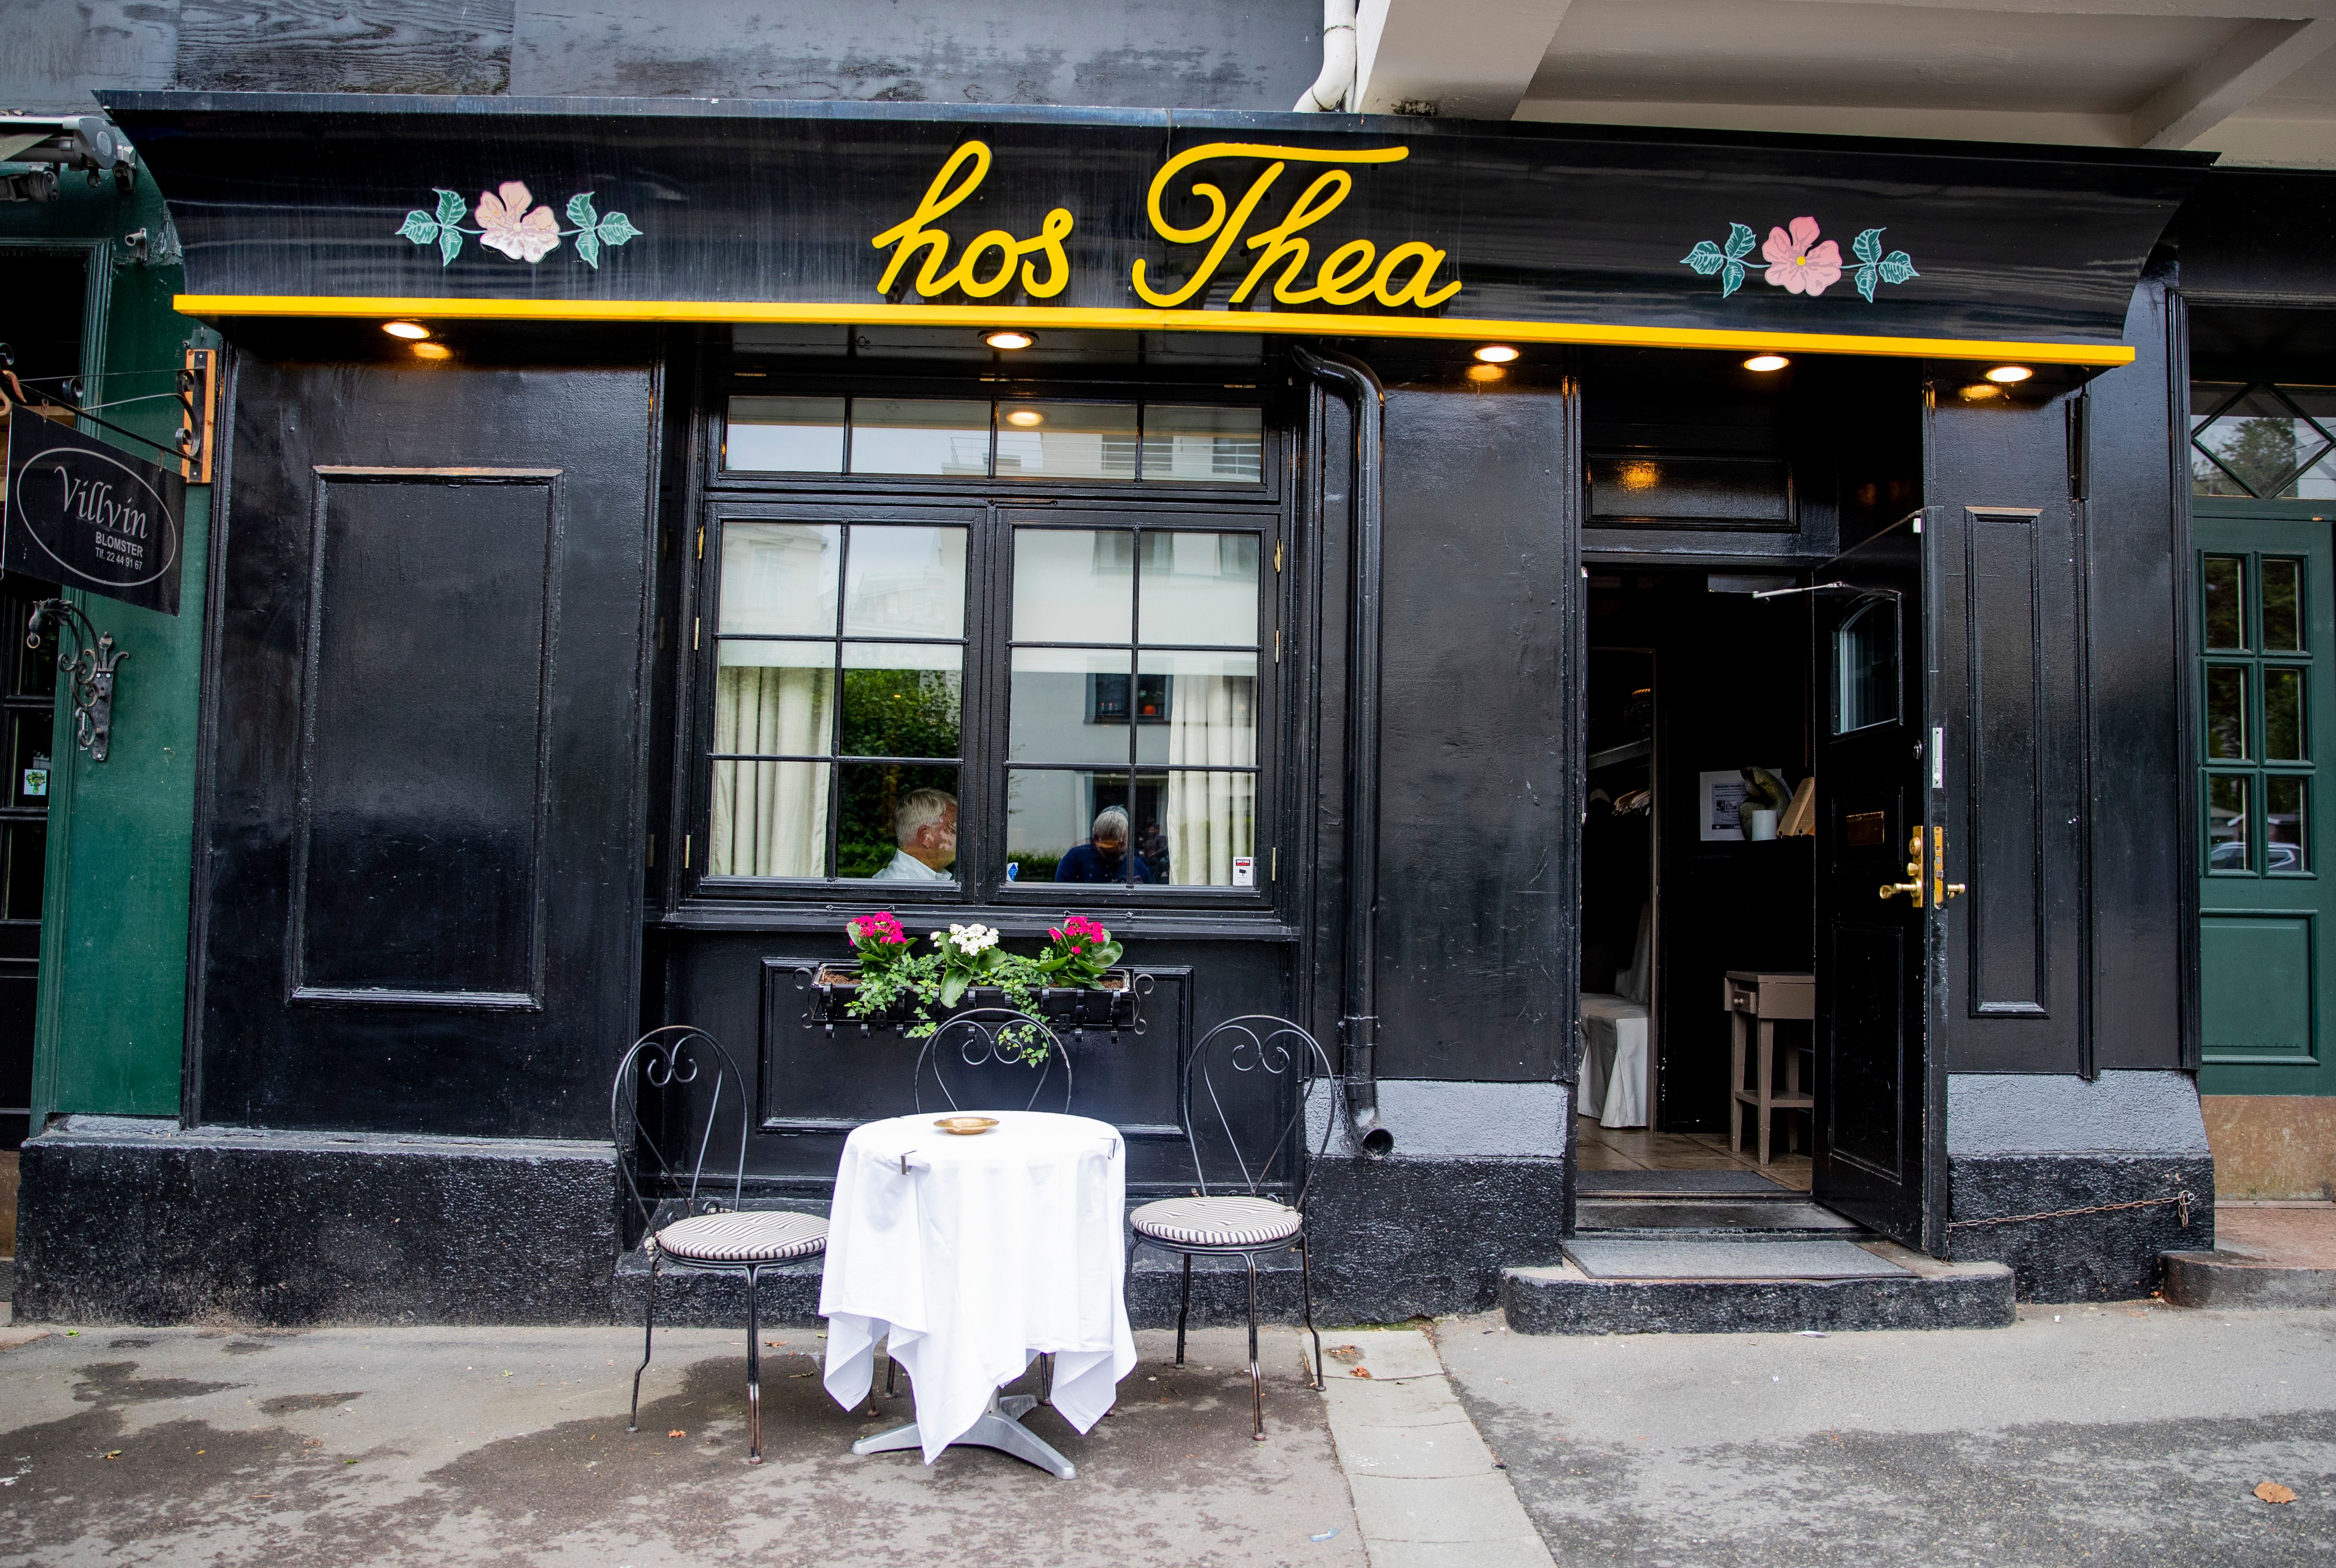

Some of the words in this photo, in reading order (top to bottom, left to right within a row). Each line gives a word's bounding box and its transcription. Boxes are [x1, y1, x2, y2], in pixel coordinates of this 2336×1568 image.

[871, 140, 1074, 298] hos
[1131, 142, 1463, 308] Thea
[54, 466, 147, 539] Villvin
[95, 547, 105, 559] Tlf.
[107, 551, 115, 562] 22
[116, 555, 124, 565] 44
[126, 557, 133, 568] 91
[135, 560, 143, 570] 67
[96, 531, 143, 558] BLOMSTER
